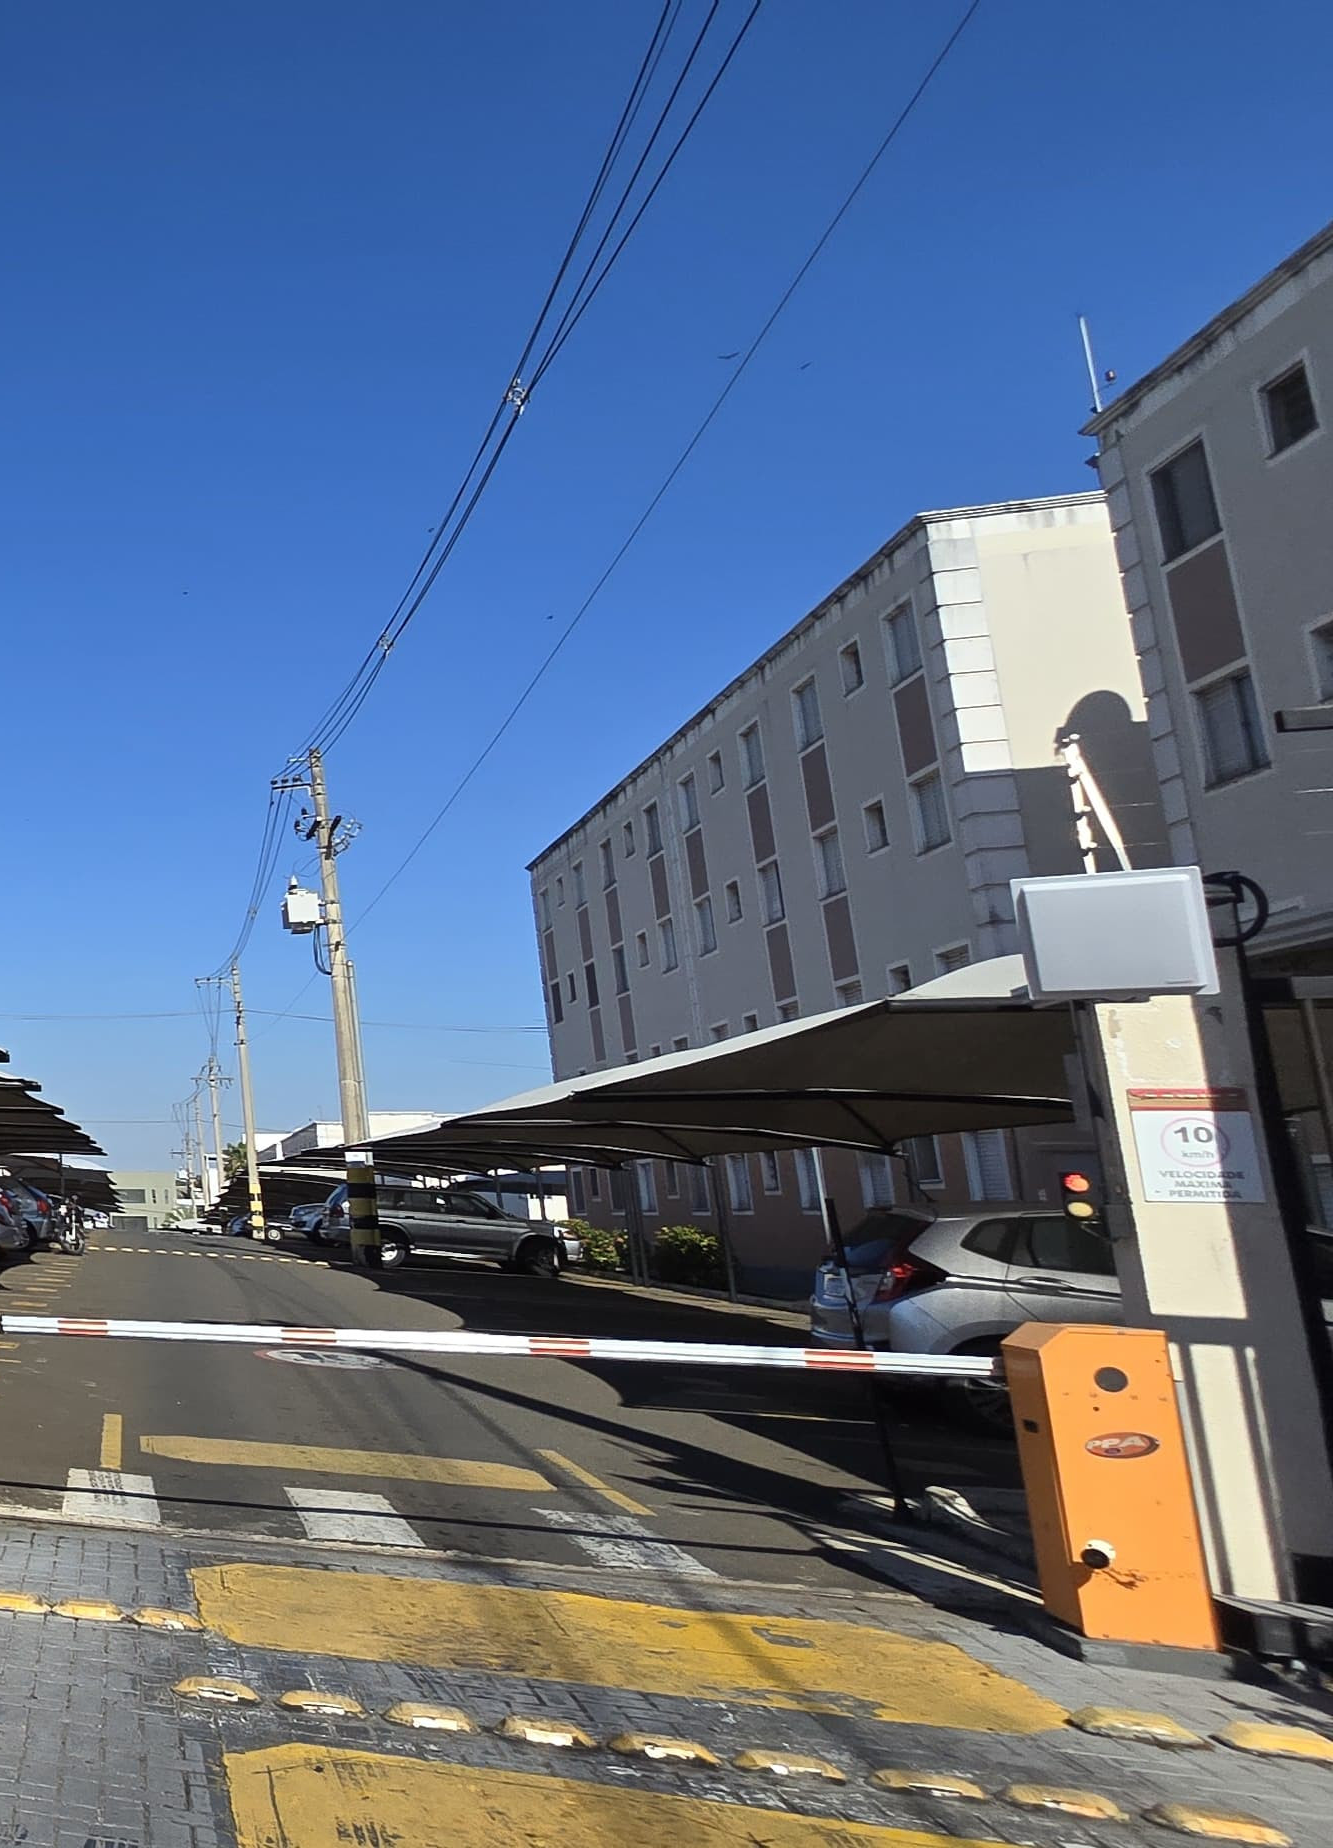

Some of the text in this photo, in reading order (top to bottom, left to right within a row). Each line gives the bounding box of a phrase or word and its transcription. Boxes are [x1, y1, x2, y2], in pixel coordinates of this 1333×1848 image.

[1173, 1126, 1214, 1144] 10
[1159, 1171, 1245, 1180] VELOCIDADE
[1169, 1190, 1242, 1199] PERMITIDA
